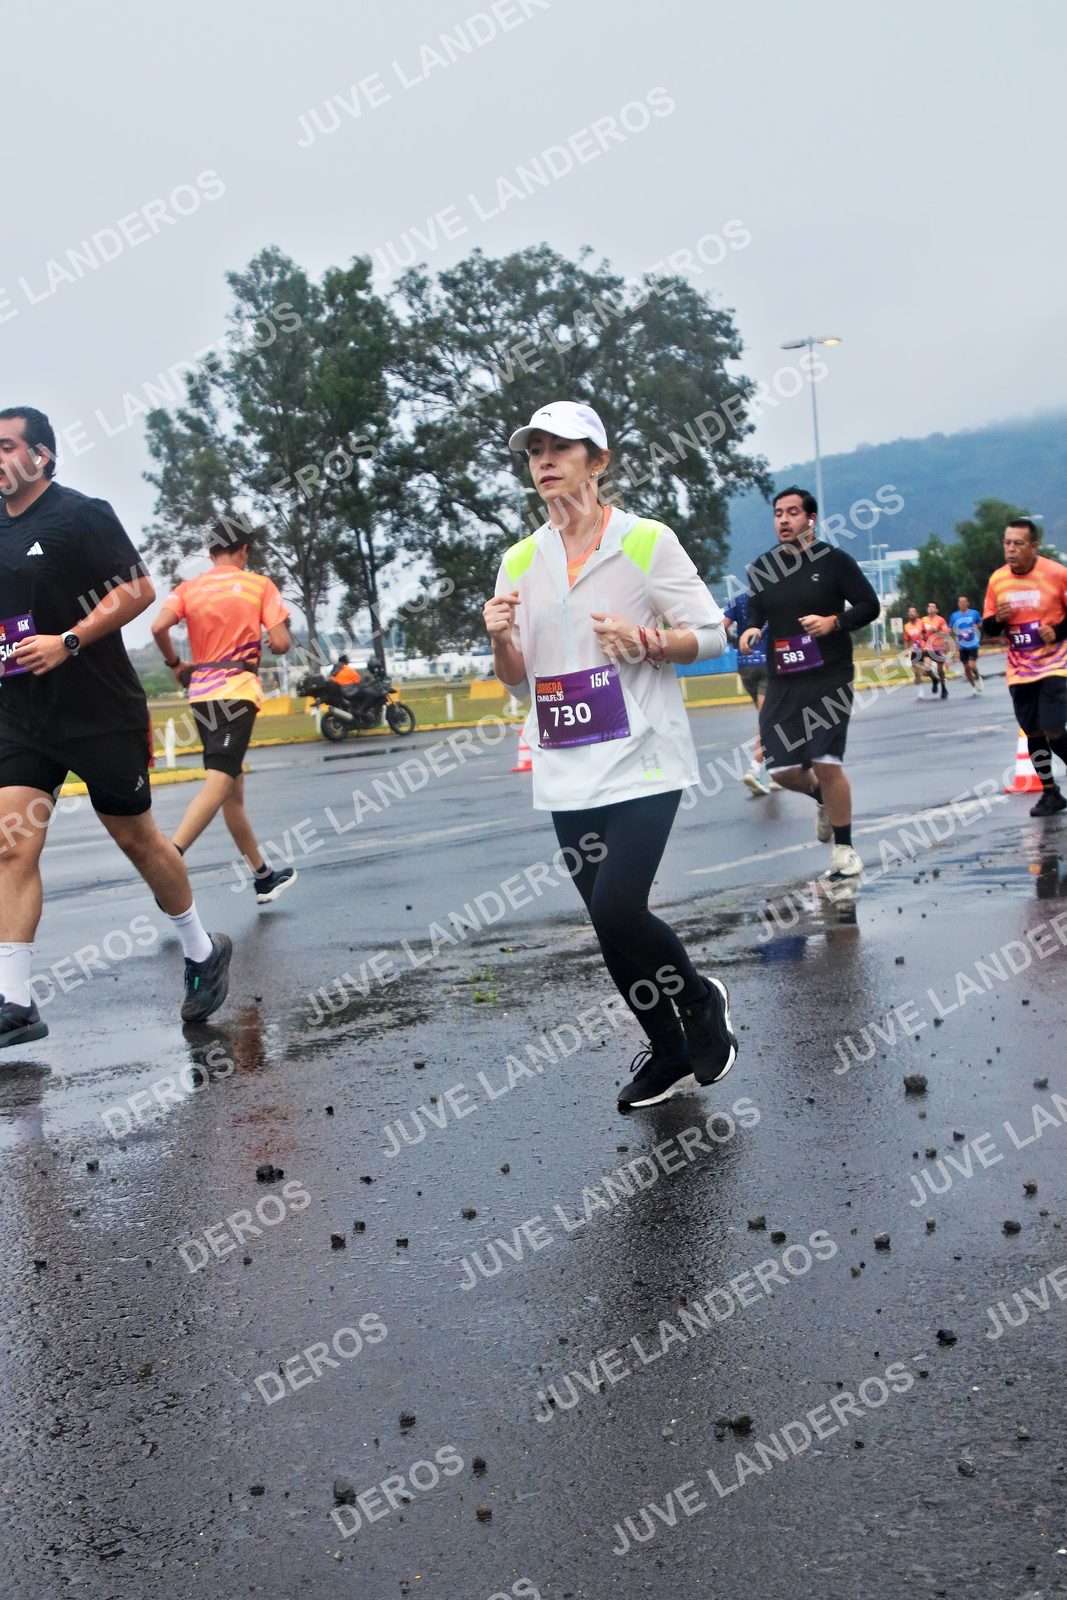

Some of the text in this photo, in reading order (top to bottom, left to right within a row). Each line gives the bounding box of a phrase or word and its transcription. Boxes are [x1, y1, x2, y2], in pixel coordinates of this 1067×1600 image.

[1014, 634, 1031, 644] 373
[783, 650, 805, 664] 583
[590, 671, 610, 689] 15K
[550, 702, 592, 727] 730
